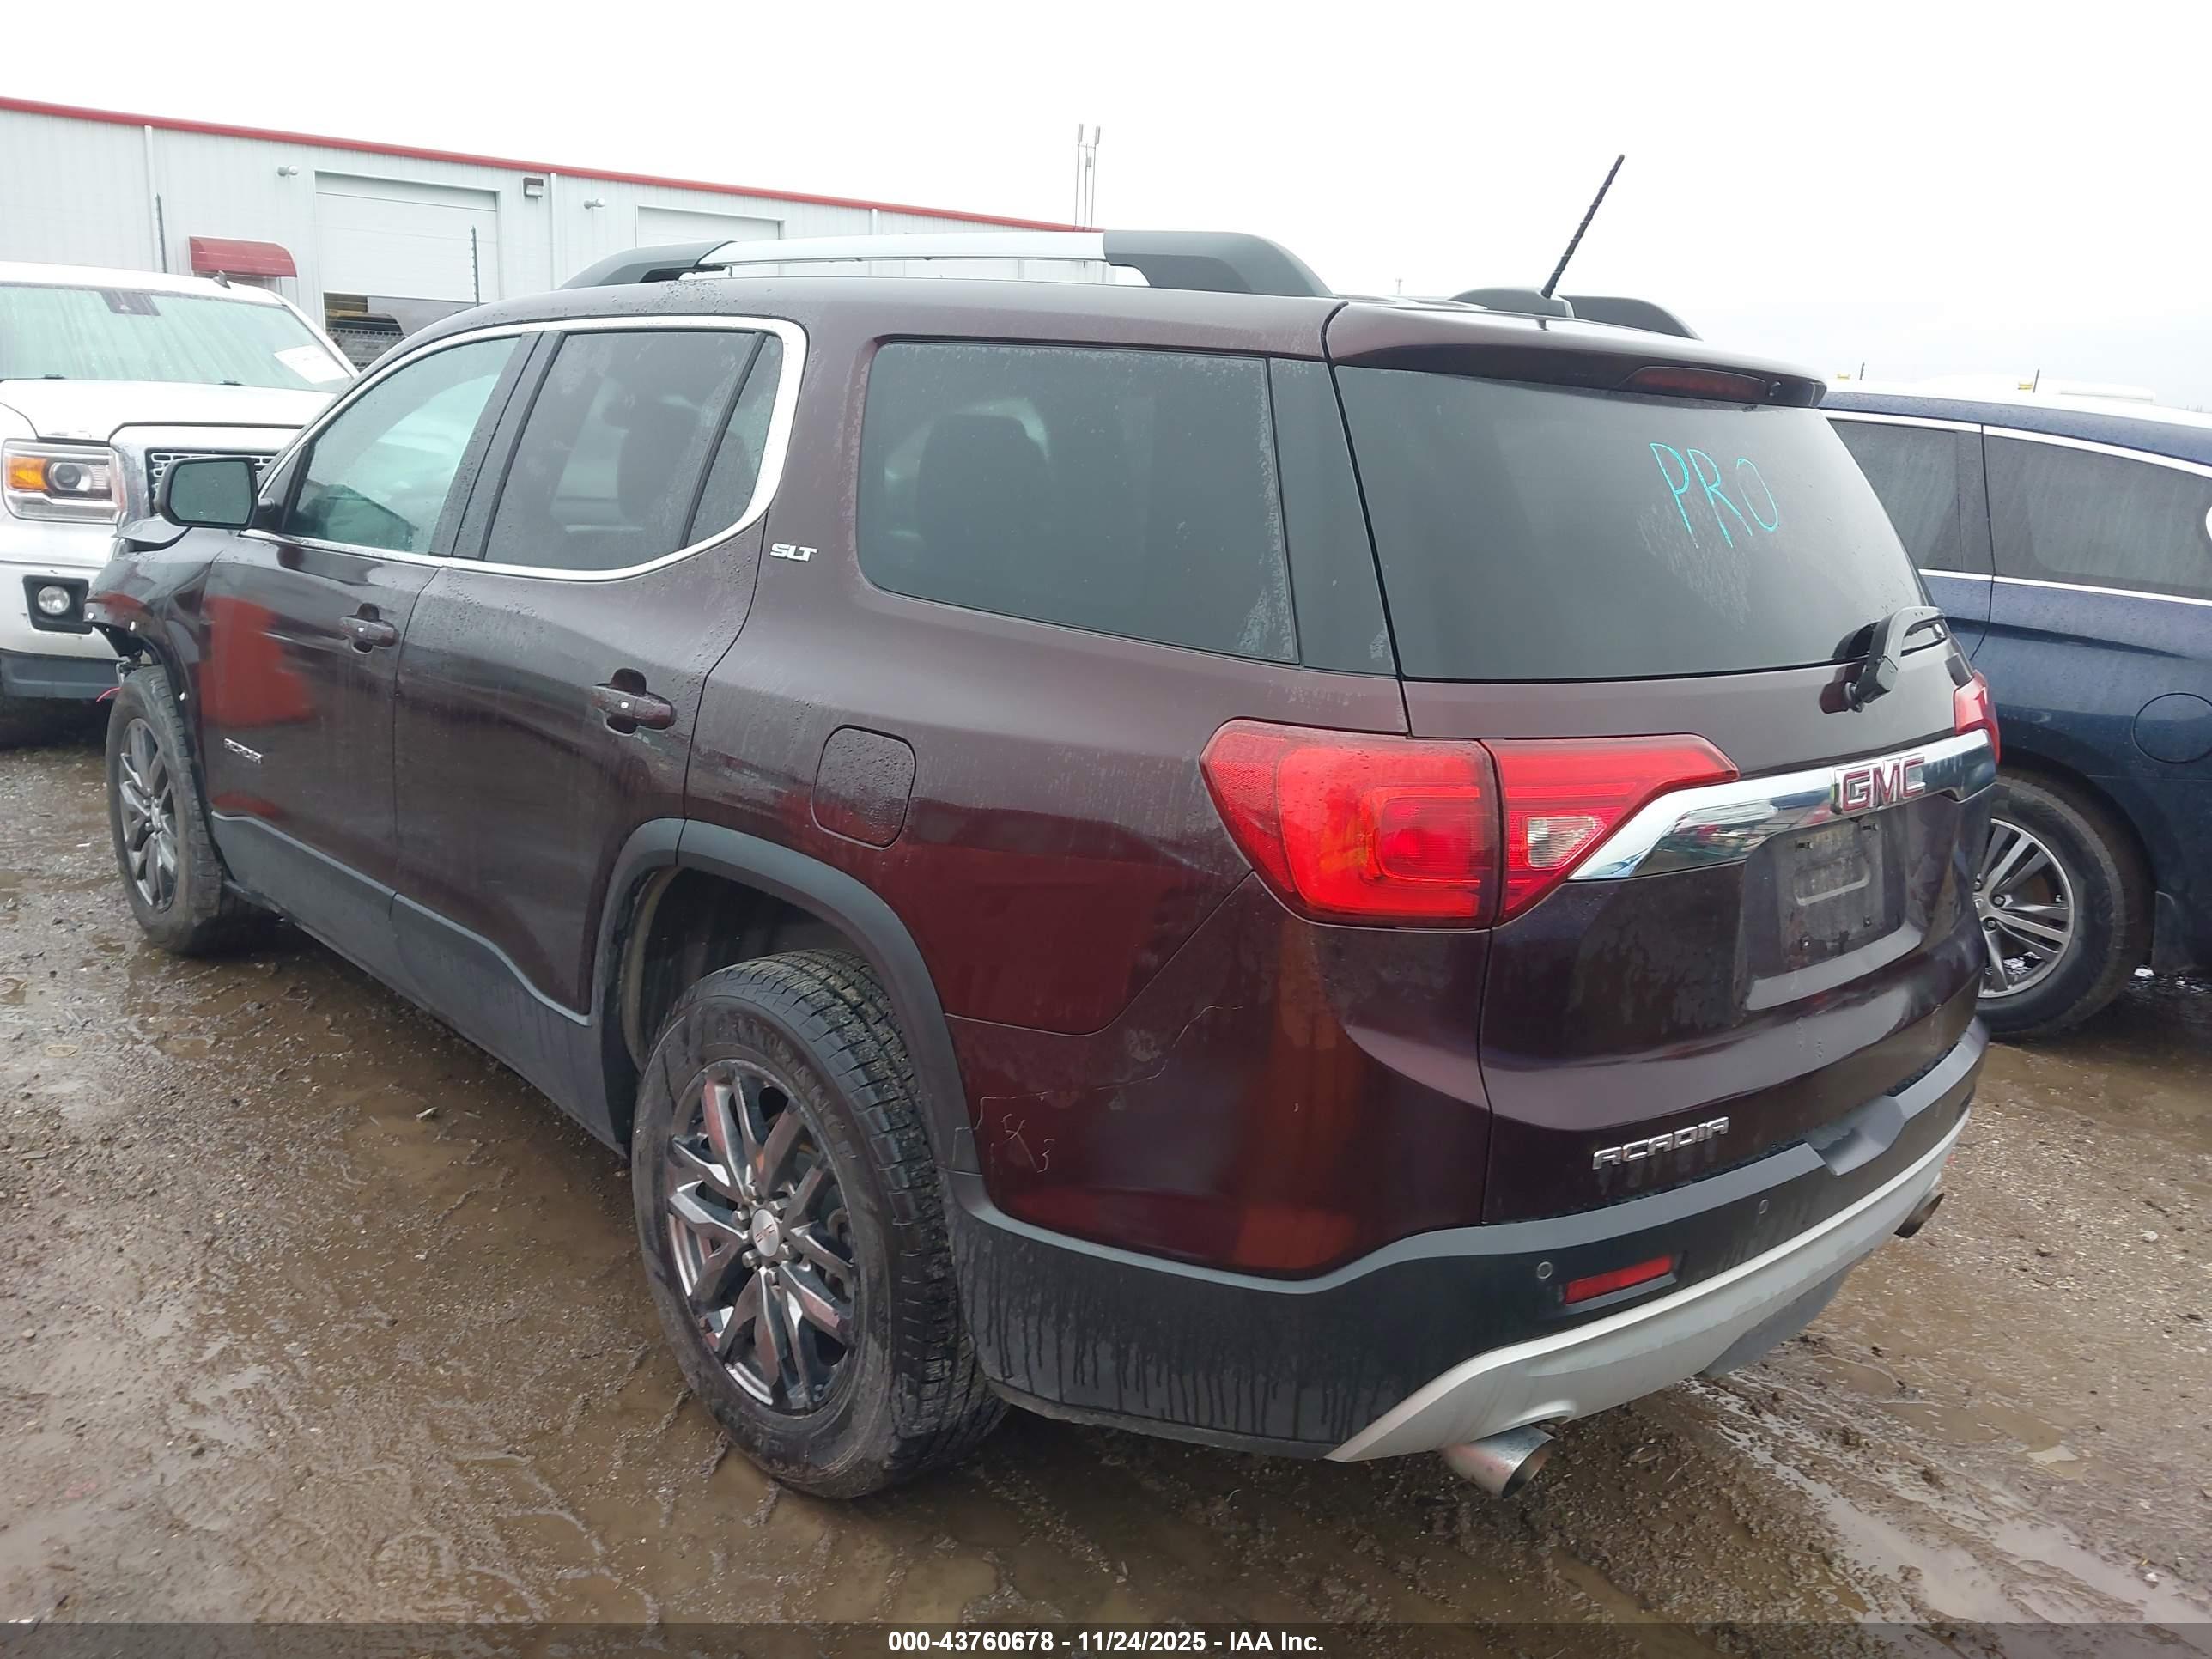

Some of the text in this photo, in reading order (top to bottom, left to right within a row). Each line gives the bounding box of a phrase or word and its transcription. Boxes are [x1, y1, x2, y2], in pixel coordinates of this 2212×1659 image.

[1650, 442, 1779, 549] PRO
[770, 543, 818, 562] SLT
[1835, 755, 1926, 811] GMC
[1592, 1116, 1729, 1170] ACADIA
